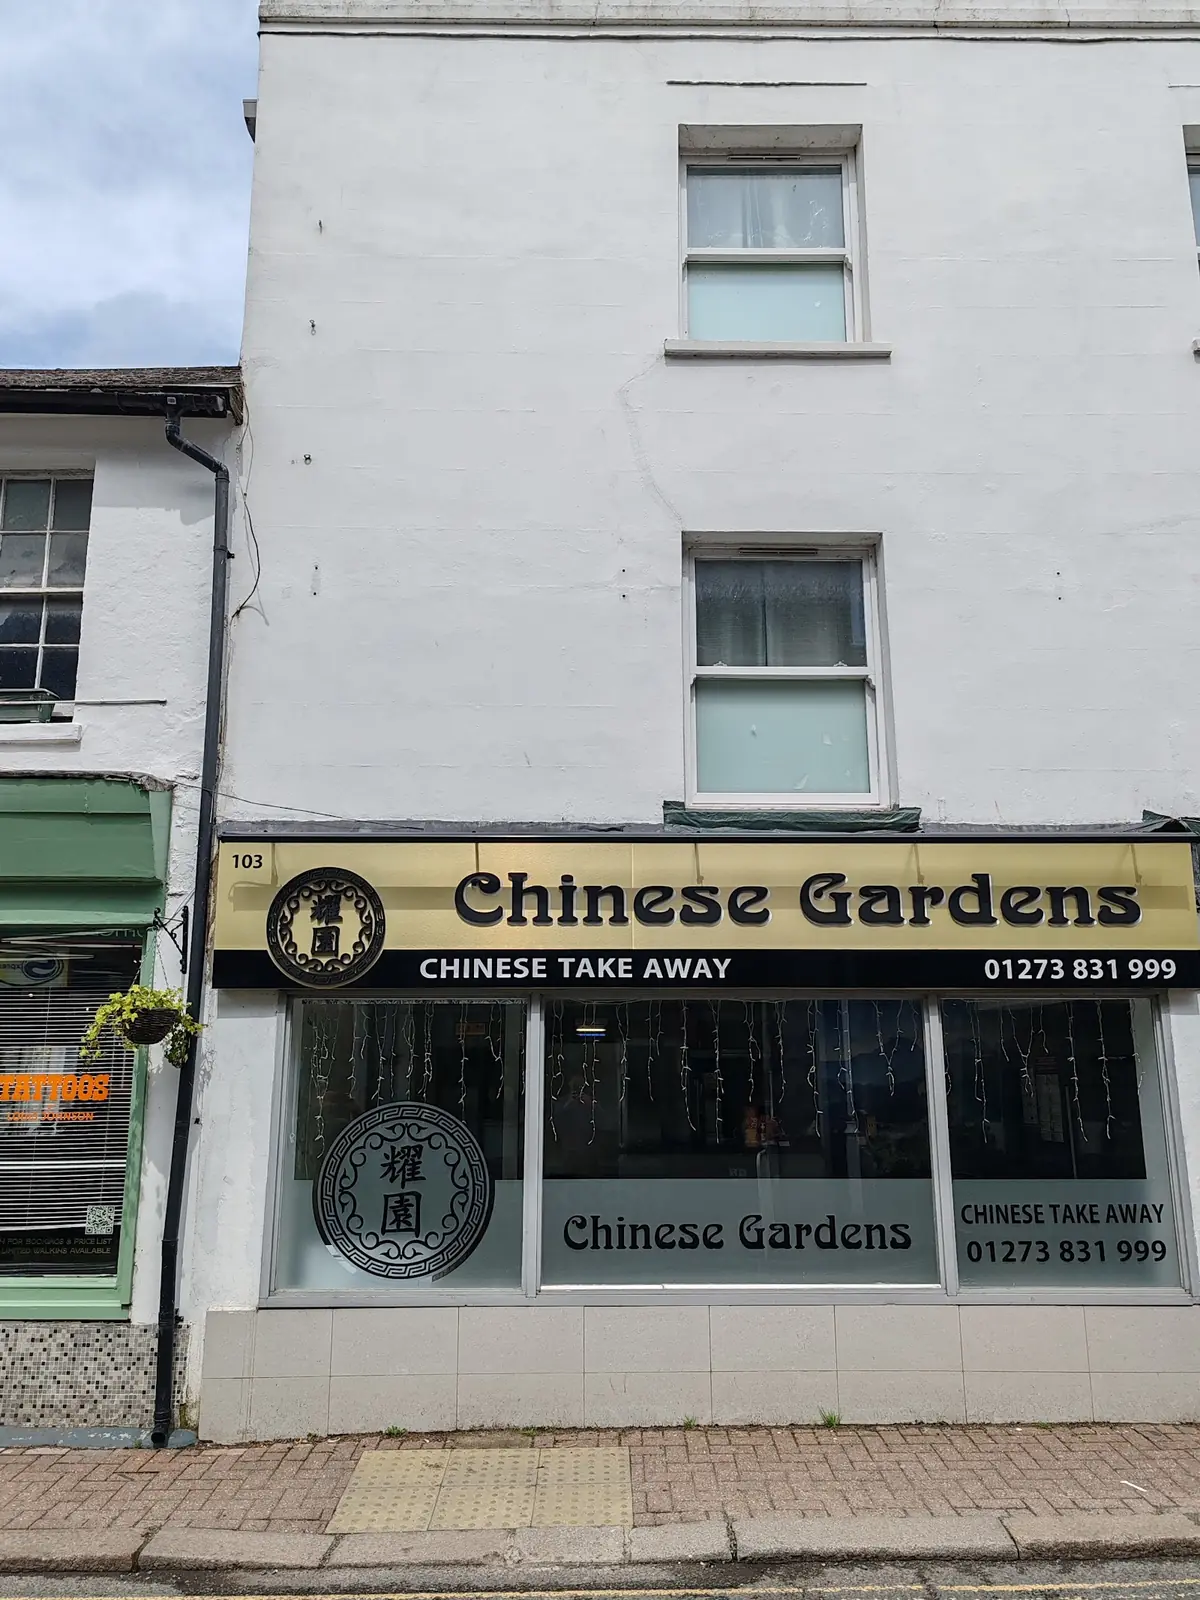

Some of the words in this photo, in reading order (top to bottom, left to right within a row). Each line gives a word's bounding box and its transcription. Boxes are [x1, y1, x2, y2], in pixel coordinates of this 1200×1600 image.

[231, 853, 263, 869] 103
[455, 871, 770, 929] Chinese
[800, 872, 1142, 929] Gardens
[419, 957, 548, 979] CHINESE
[557, 957, 633, 978] TAKE
[642, 957, 732, 979] AWAY
[984, 958, 1065, 980] 01273
[1072, 958, 1118, 980] 831
[1128, 958, 1177, 980] 999
[0, 1074, 109, 1101] TATTOOS
[41, 1111, 94, 1121] JOHNSON
[379, 1143, 427, 1239] 耀園
[960, 1203, 1045, 1225] CHINESE
[1048, 1203, 1101, 1225] TAKE
[1105, 1203, 1165, 1225] AWAY
[563, 1214, 725, 1251] Chinese
[738, 1214, 912, 1250] Gardens
[69, 1247, 111, 1255] AVAILABLE
[966, 1240, 1051, 1263] 01273
[1059, 1240, 1106, 1263] 831
[1116, 1239, 1168, 1263] 999
